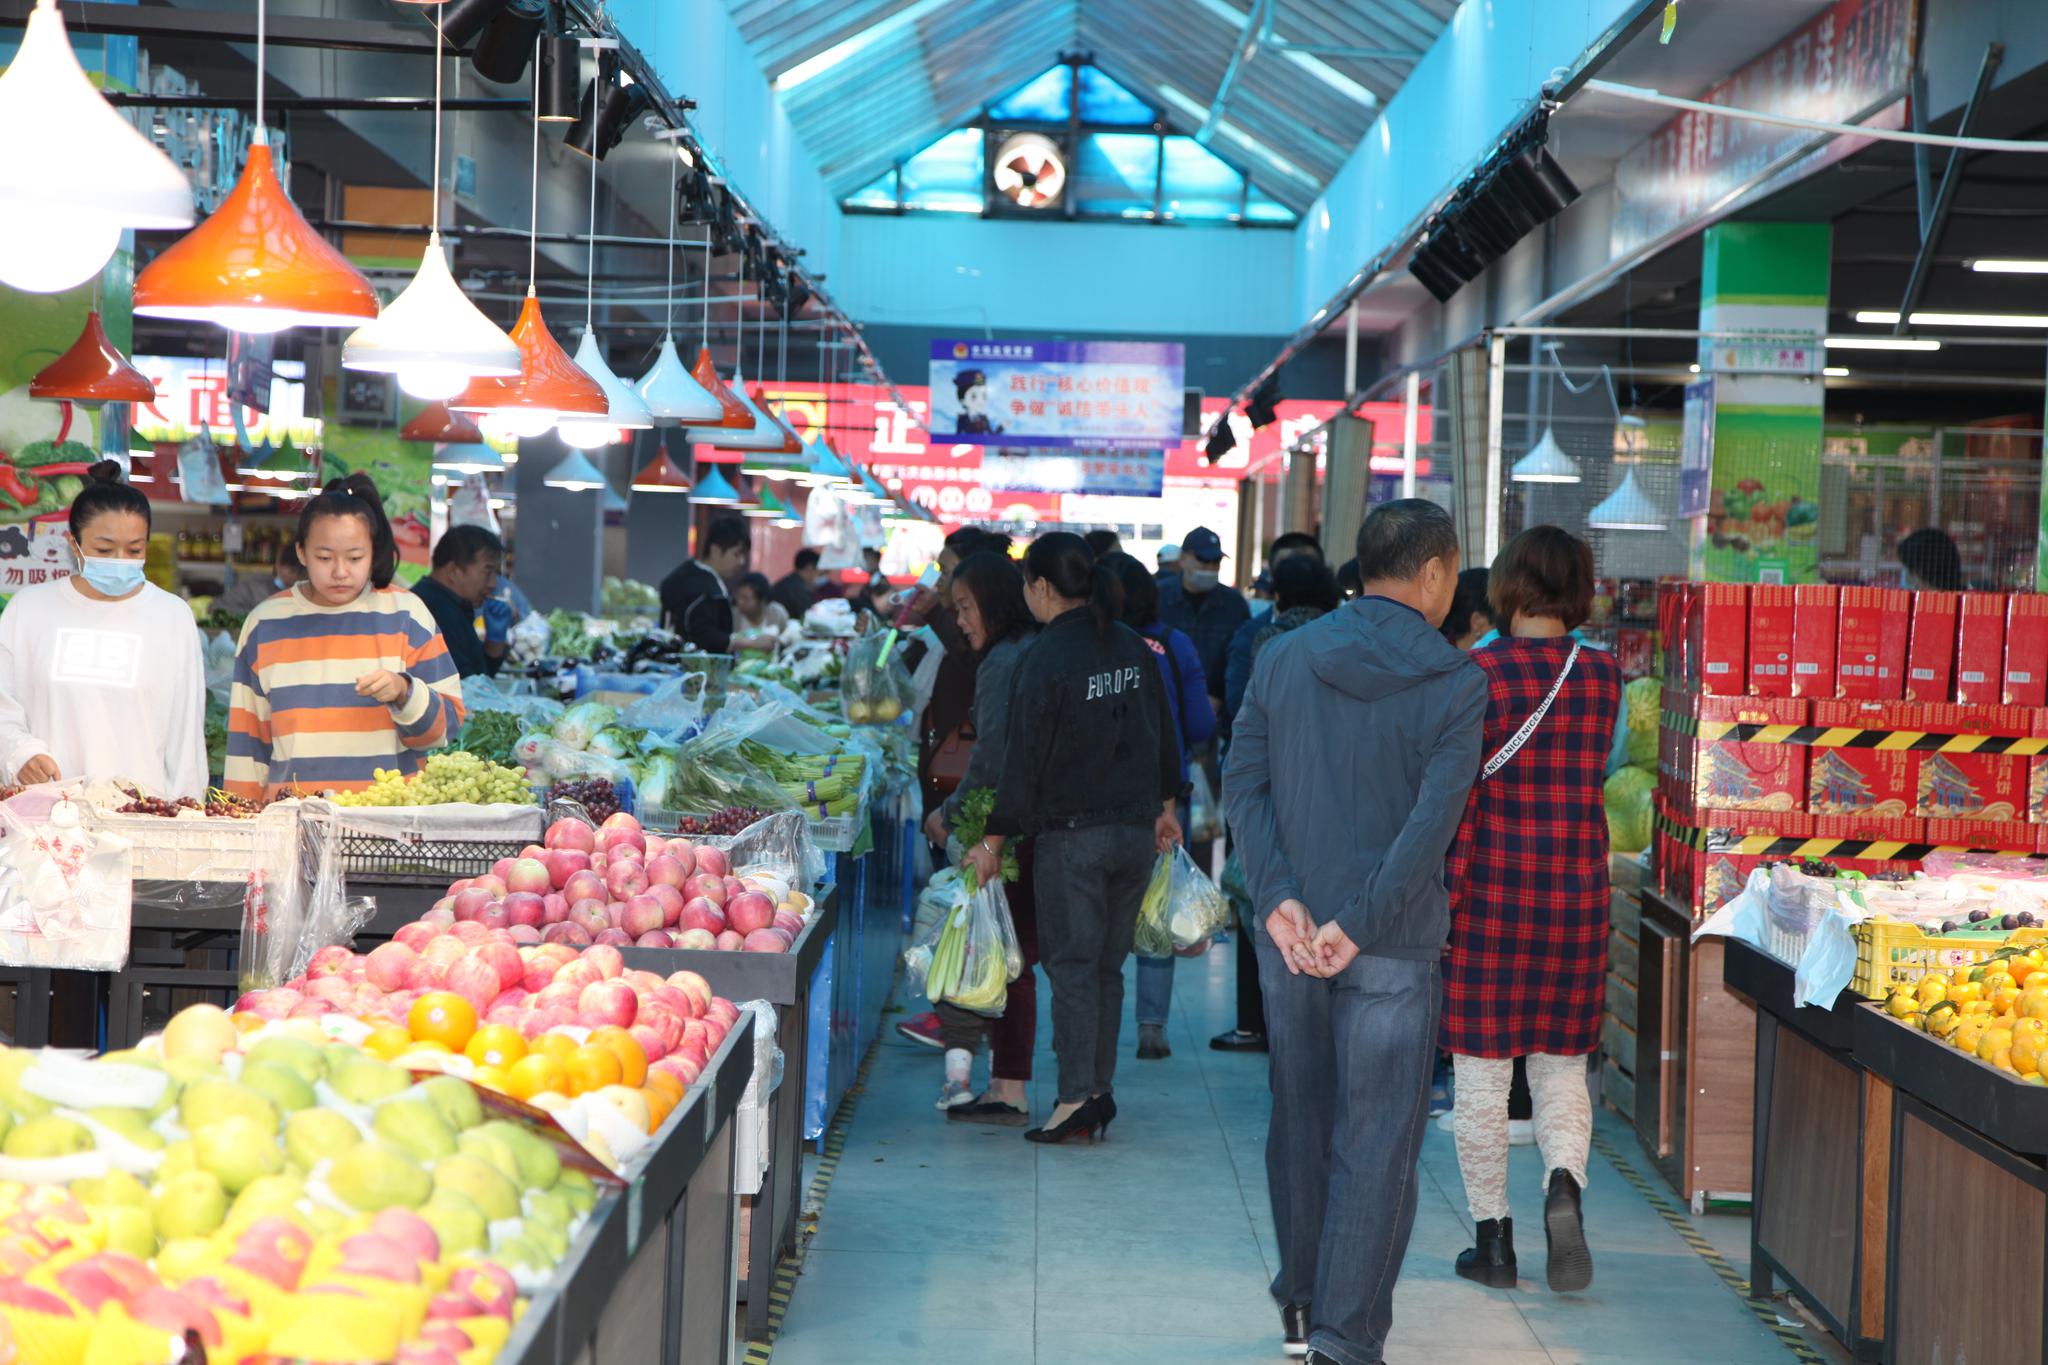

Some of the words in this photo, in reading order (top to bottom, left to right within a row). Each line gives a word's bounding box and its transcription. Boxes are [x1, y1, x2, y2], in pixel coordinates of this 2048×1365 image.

[0, 567, 70, 584] 勿吸烟
[1086, 667, 1140, 700] EUROPE
